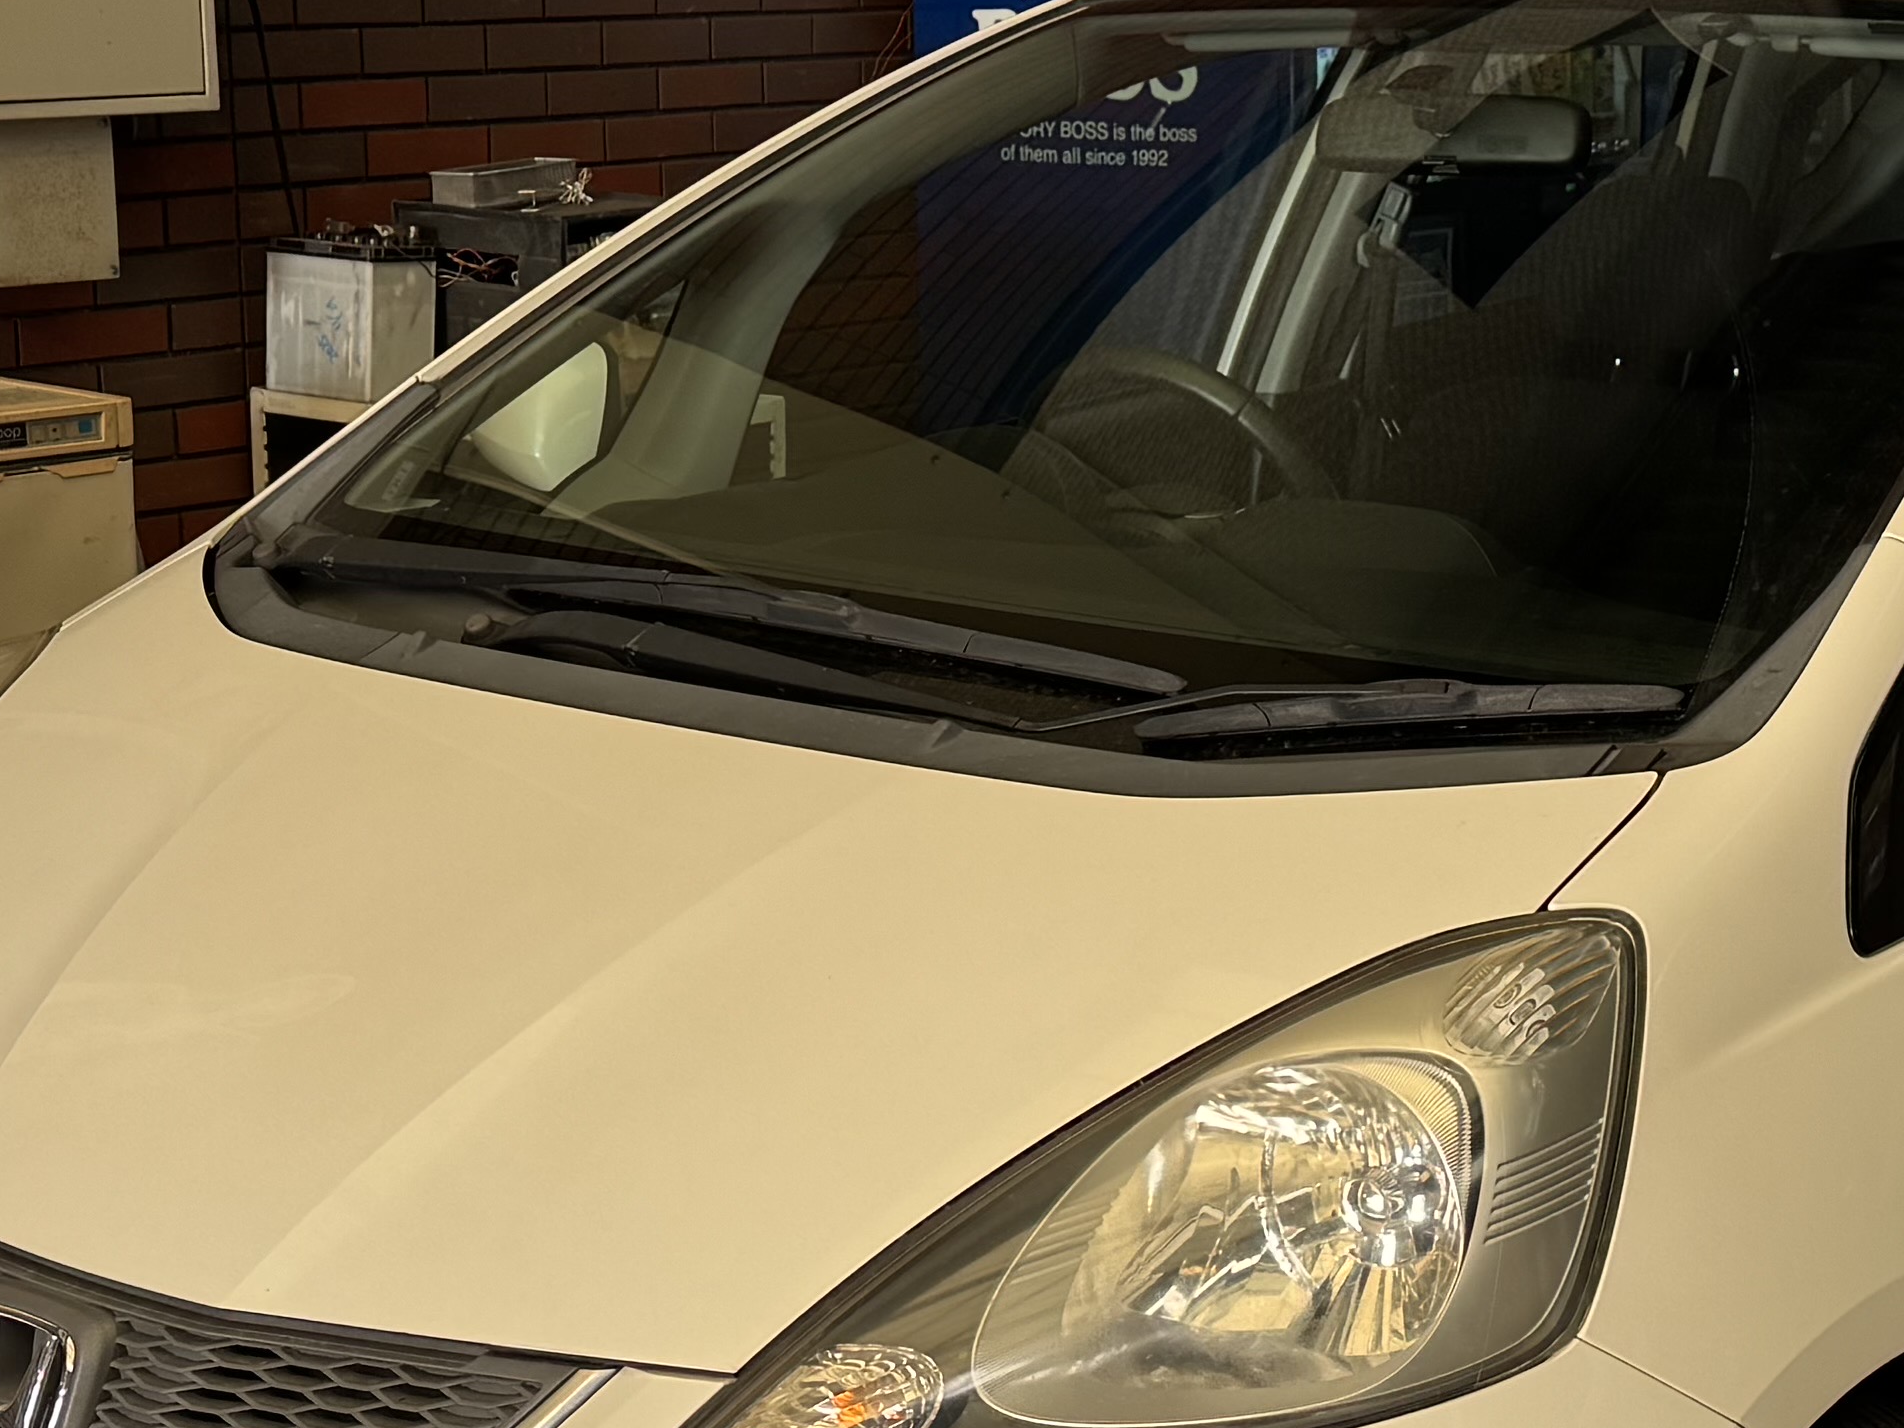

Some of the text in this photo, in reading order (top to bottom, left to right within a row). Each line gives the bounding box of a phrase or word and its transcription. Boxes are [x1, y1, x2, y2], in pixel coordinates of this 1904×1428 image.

[1060, 121, 1109, 140] BOSS
[1113, 123, 1126, 141] is
[1131, 123, 1155, 142] the
[1159, 125, 1198, 142] boss
[1001, 144, 1169, 167] of them all since 1992
